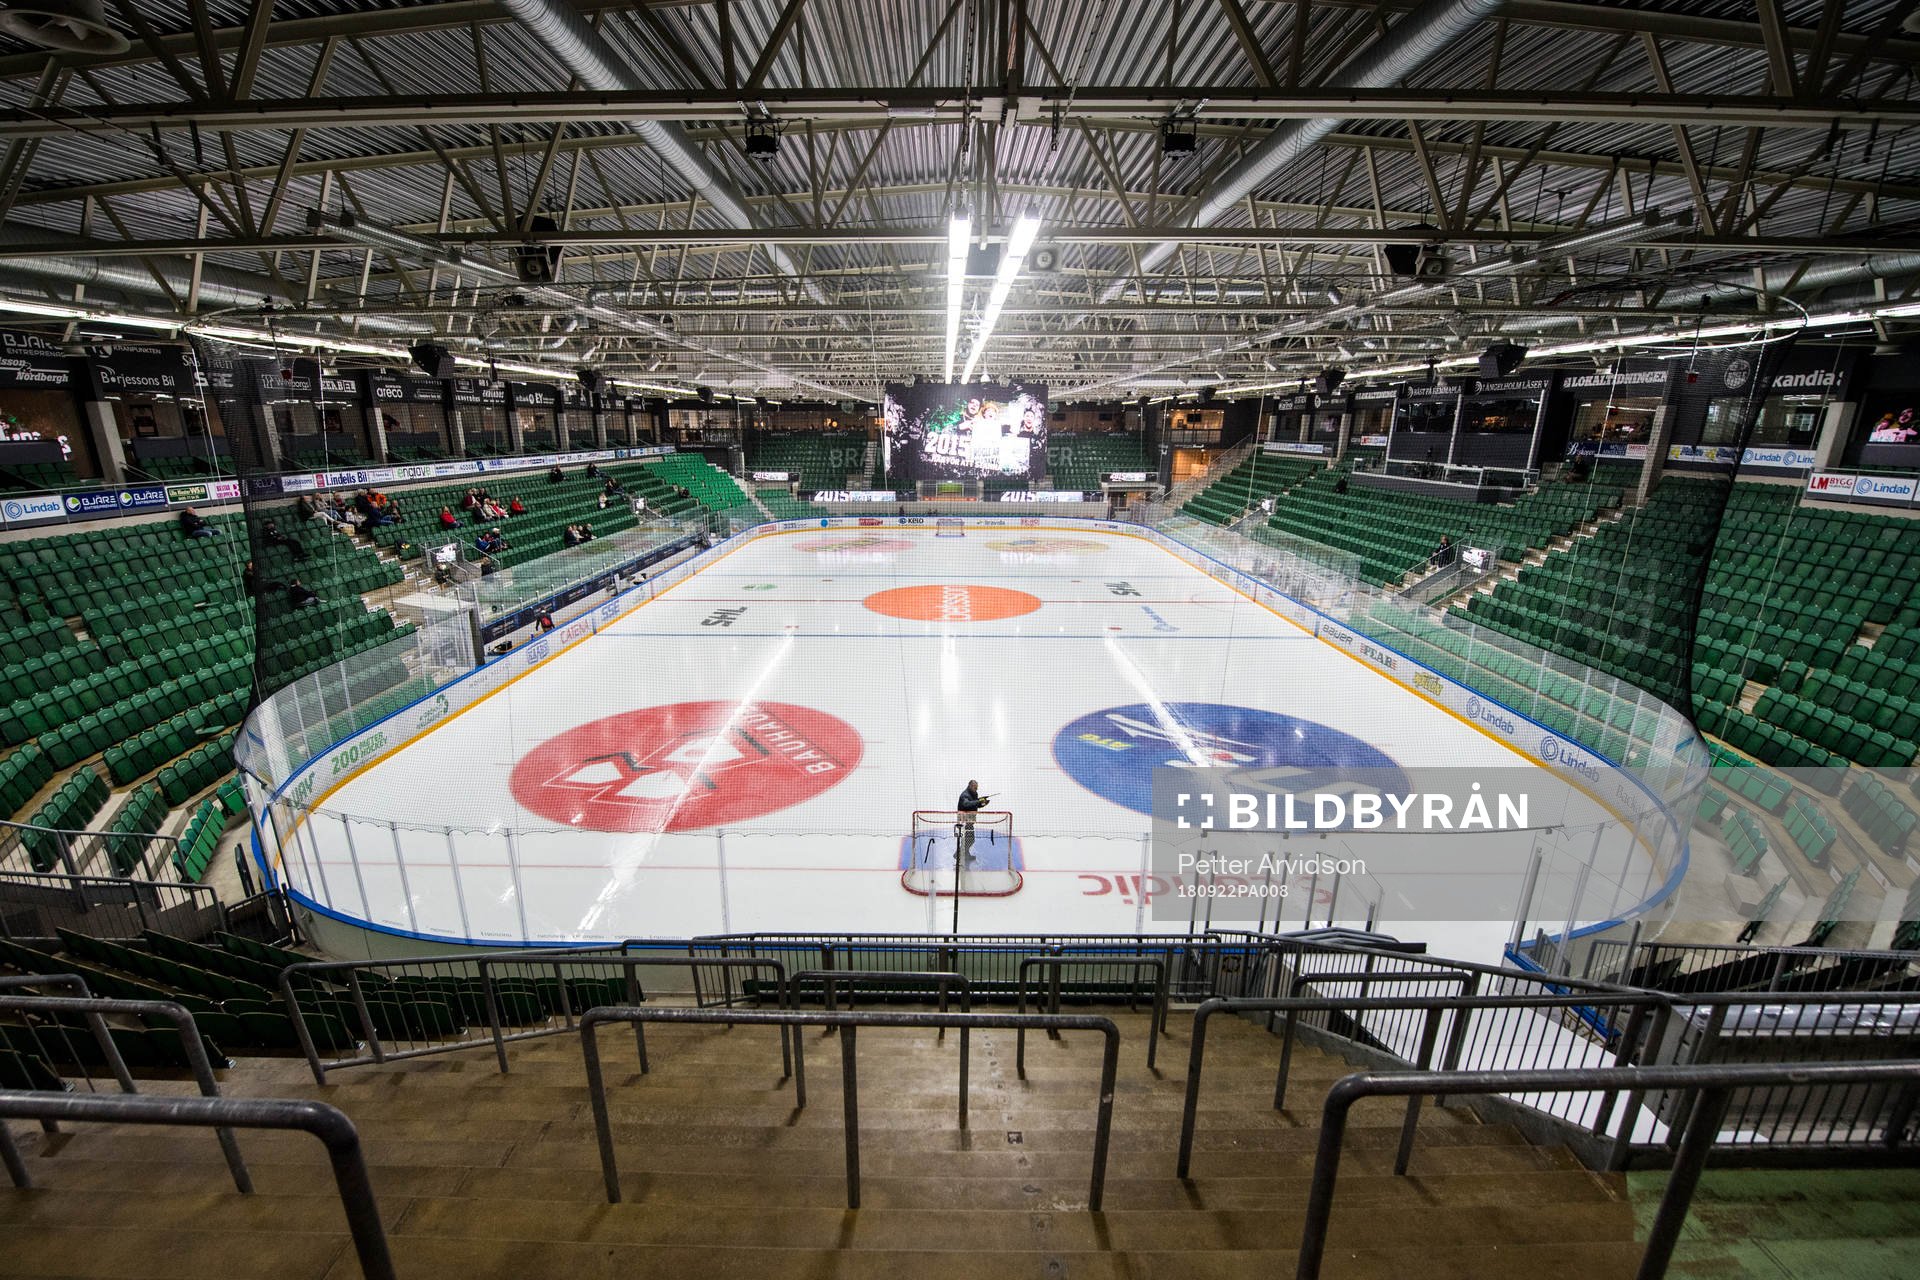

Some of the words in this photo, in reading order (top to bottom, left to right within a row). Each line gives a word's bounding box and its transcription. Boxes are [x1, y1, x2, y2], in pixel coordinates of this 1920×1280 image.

[16, 372, 69, 384] Nordbergh
[162, 375, 175, 386] Bil
[1572, 371, 1668, 387] LOKALTIDNINGEN
[377, 387, 403, 399] areco
[1755, 453, 1781, 462] Lindab
[325, 471, 355, 486] Lindells
[358, 470, 367, 483] Bil
[1810, 477, 1829, 489] LM
[1829, 478, 1853, 486] BYGG
[1873, 483, 1910, 494] Lindab
[82, 496, 116, 506] BJÄRE
[133, 491, 164, 500] BJÄRE
[23, 502, 60, 514] Lindab
[700, 606, 748, 627] SHL
[1481, 707, 1515, 735] Lindab
[331, 745, 359, 776] 200
[1559, 749, 1600, 784] Lindab
